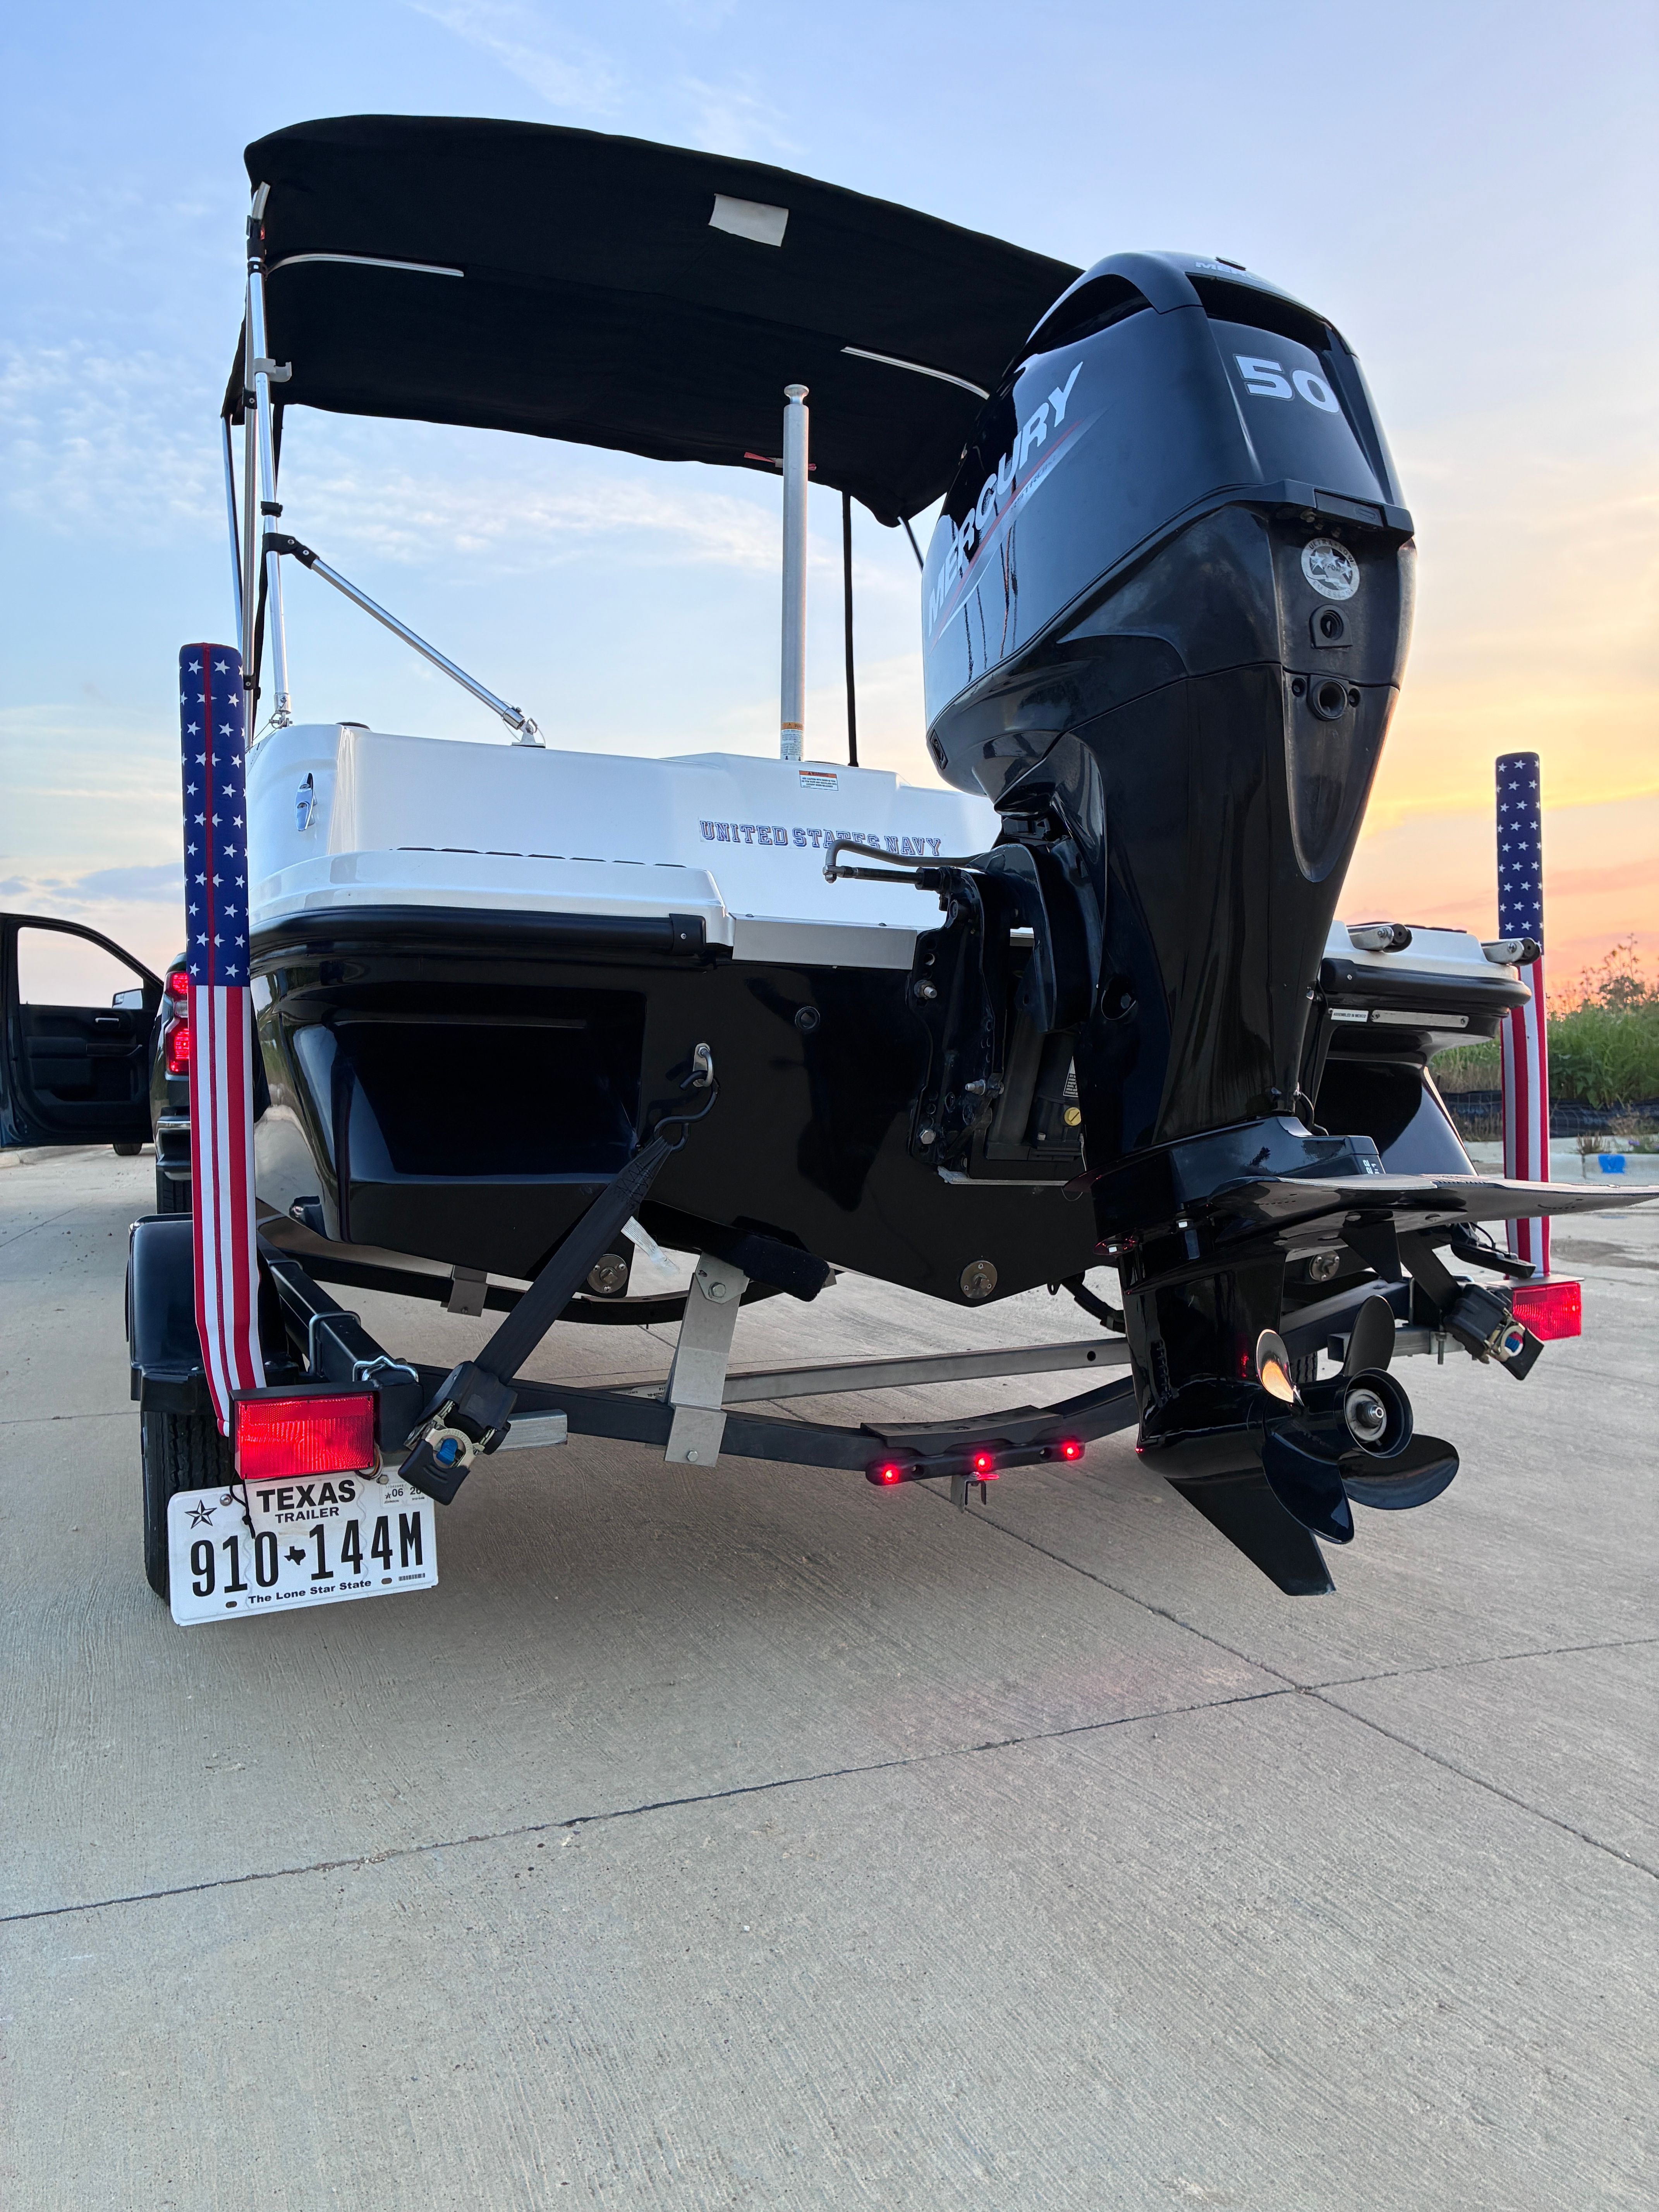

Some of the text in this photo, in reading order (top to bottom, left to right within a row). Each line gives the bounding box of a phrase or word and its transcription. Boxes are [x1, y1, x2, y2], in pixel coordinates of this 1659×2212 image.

[1234, 354, 1339, 413] 50
[929, 361, 1083, 637] MERCURY
[699, 820, 788, 846] UNITED
[884, 835, 941, 856] NAVY
[256, 1480, 356, 1513] TEXAS
[392, 1488, 404, 1497] 06
[275, 1506, 340, 1524] TRAILER
[248, 1579, 371, 1604] The Lone Star State
